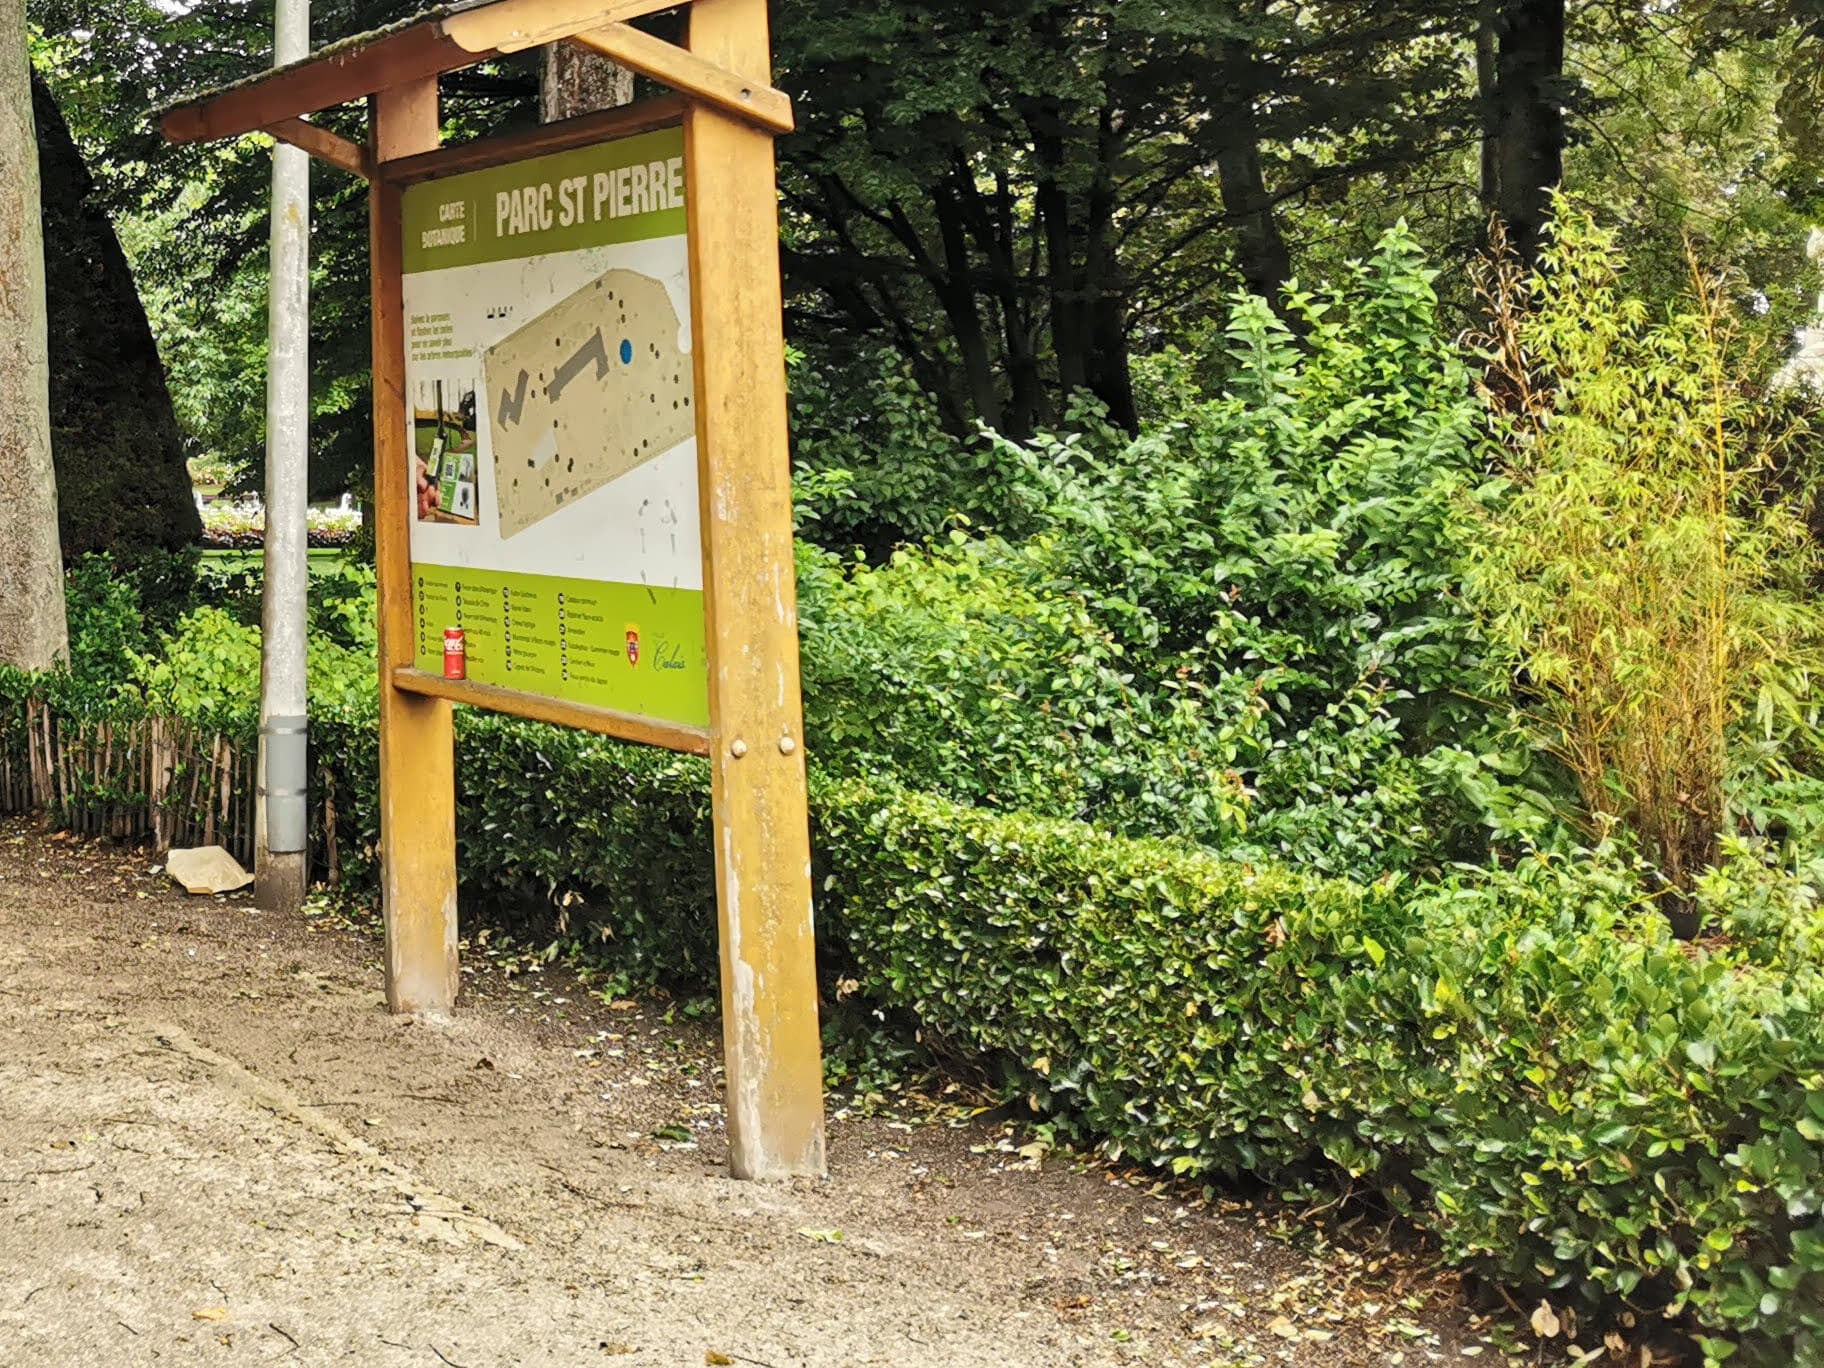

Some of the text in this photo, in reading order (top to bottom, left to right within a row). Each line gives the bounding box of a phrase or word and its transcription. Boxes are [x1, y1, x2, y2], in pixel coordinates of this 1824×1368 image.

[439, 201, 465, 222] CARTE
[496, 156, 684, 237] PARC ST PIERRE
